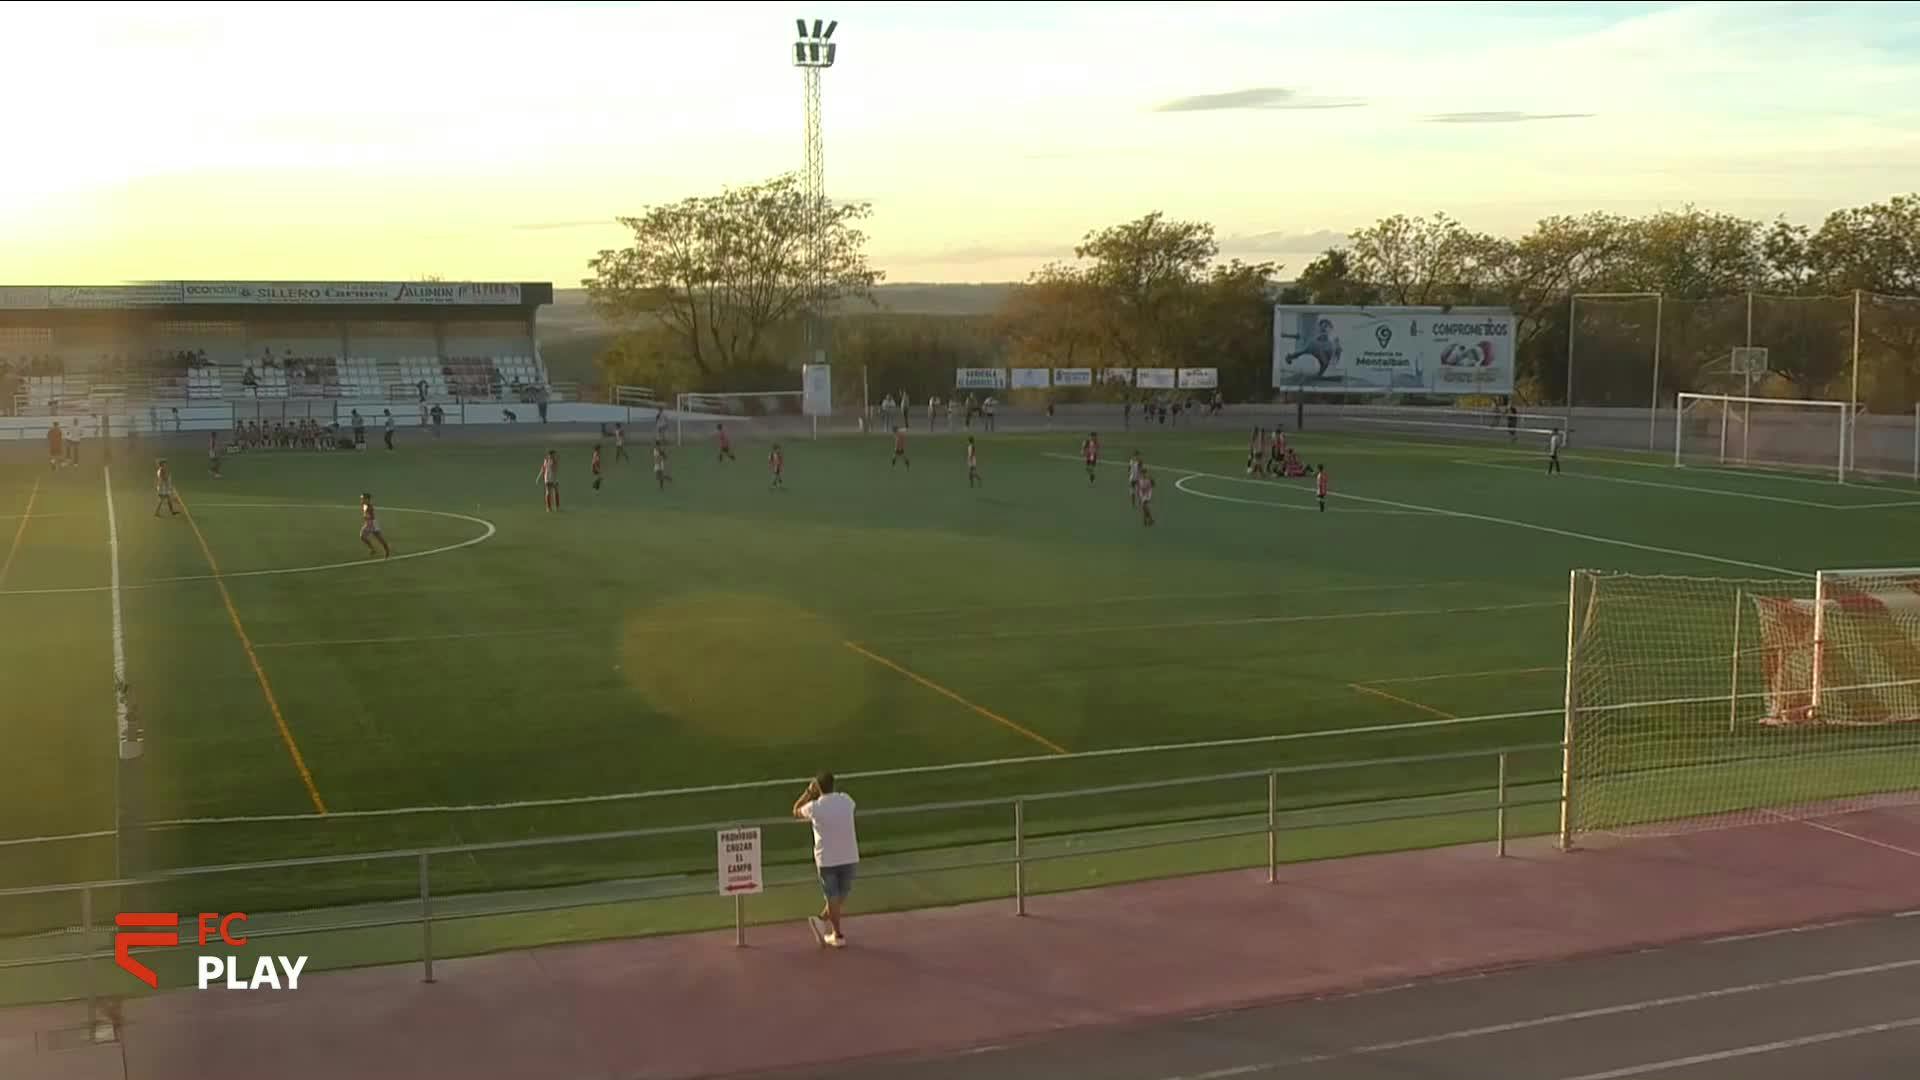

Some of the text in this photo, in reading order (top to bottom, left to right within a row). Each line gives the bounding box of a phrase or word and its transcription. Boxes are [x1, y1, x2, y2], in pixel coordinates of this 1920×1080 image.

[256, 287, 321, 298] SILLERO
[1432, 319, 1507, 336] COMPROMETIDOS
[721, 831, 757, 842] PROHIBIDO
[726, 842, 752, 852] CRUZAR
[735, 854, 743, 862] EL
[728, 863, 752, 873] CAMPO
